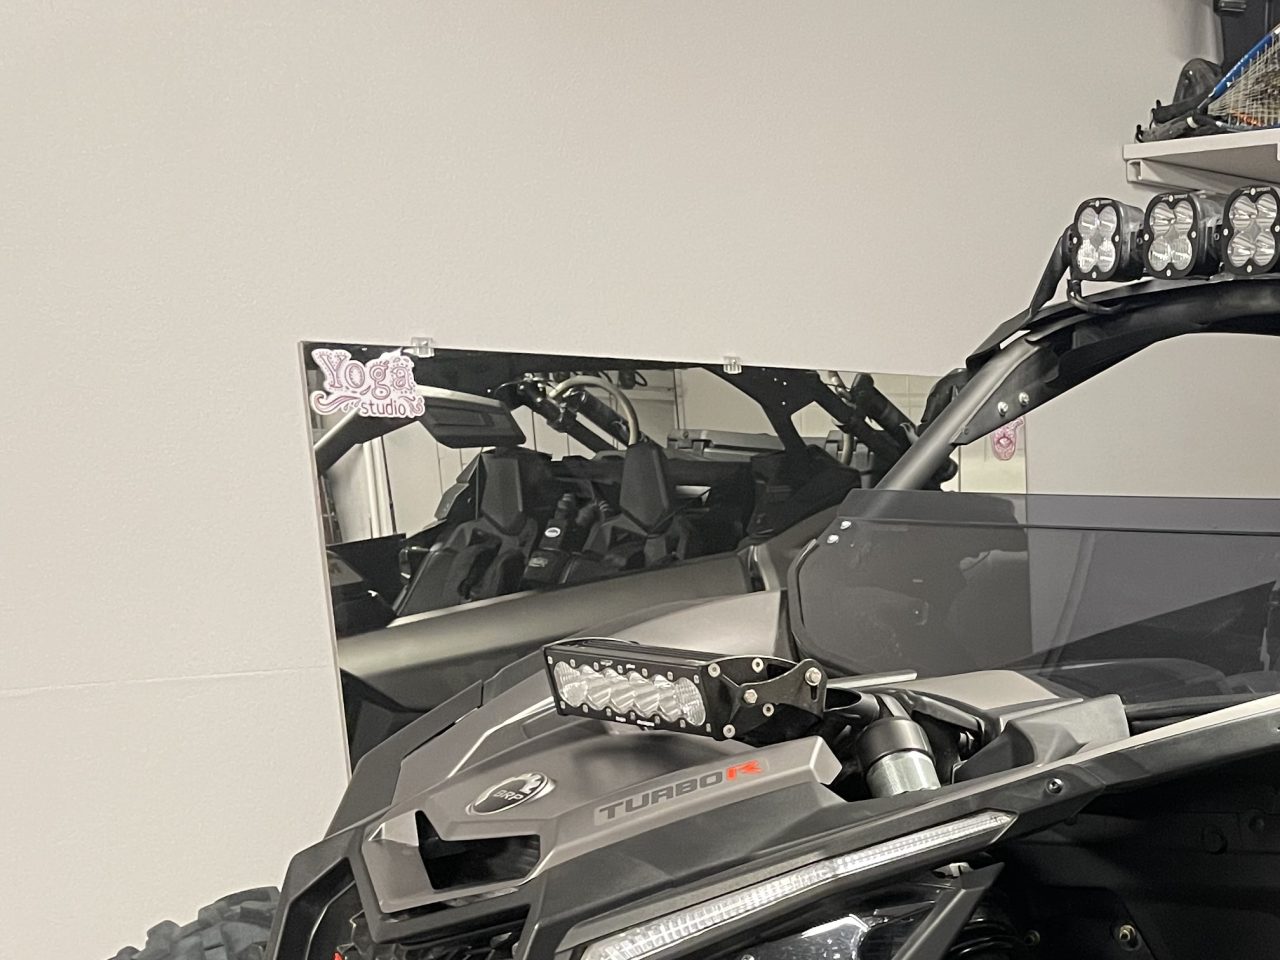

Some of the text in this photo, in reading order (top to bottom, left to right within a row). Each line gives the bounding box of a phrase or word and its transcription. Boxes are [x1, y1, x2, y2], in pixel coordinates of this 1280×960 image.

[319, 354, 413, 399] Yoga
[361, 400, 406, 416] studio
[493, 789, 525, 801] BRP
